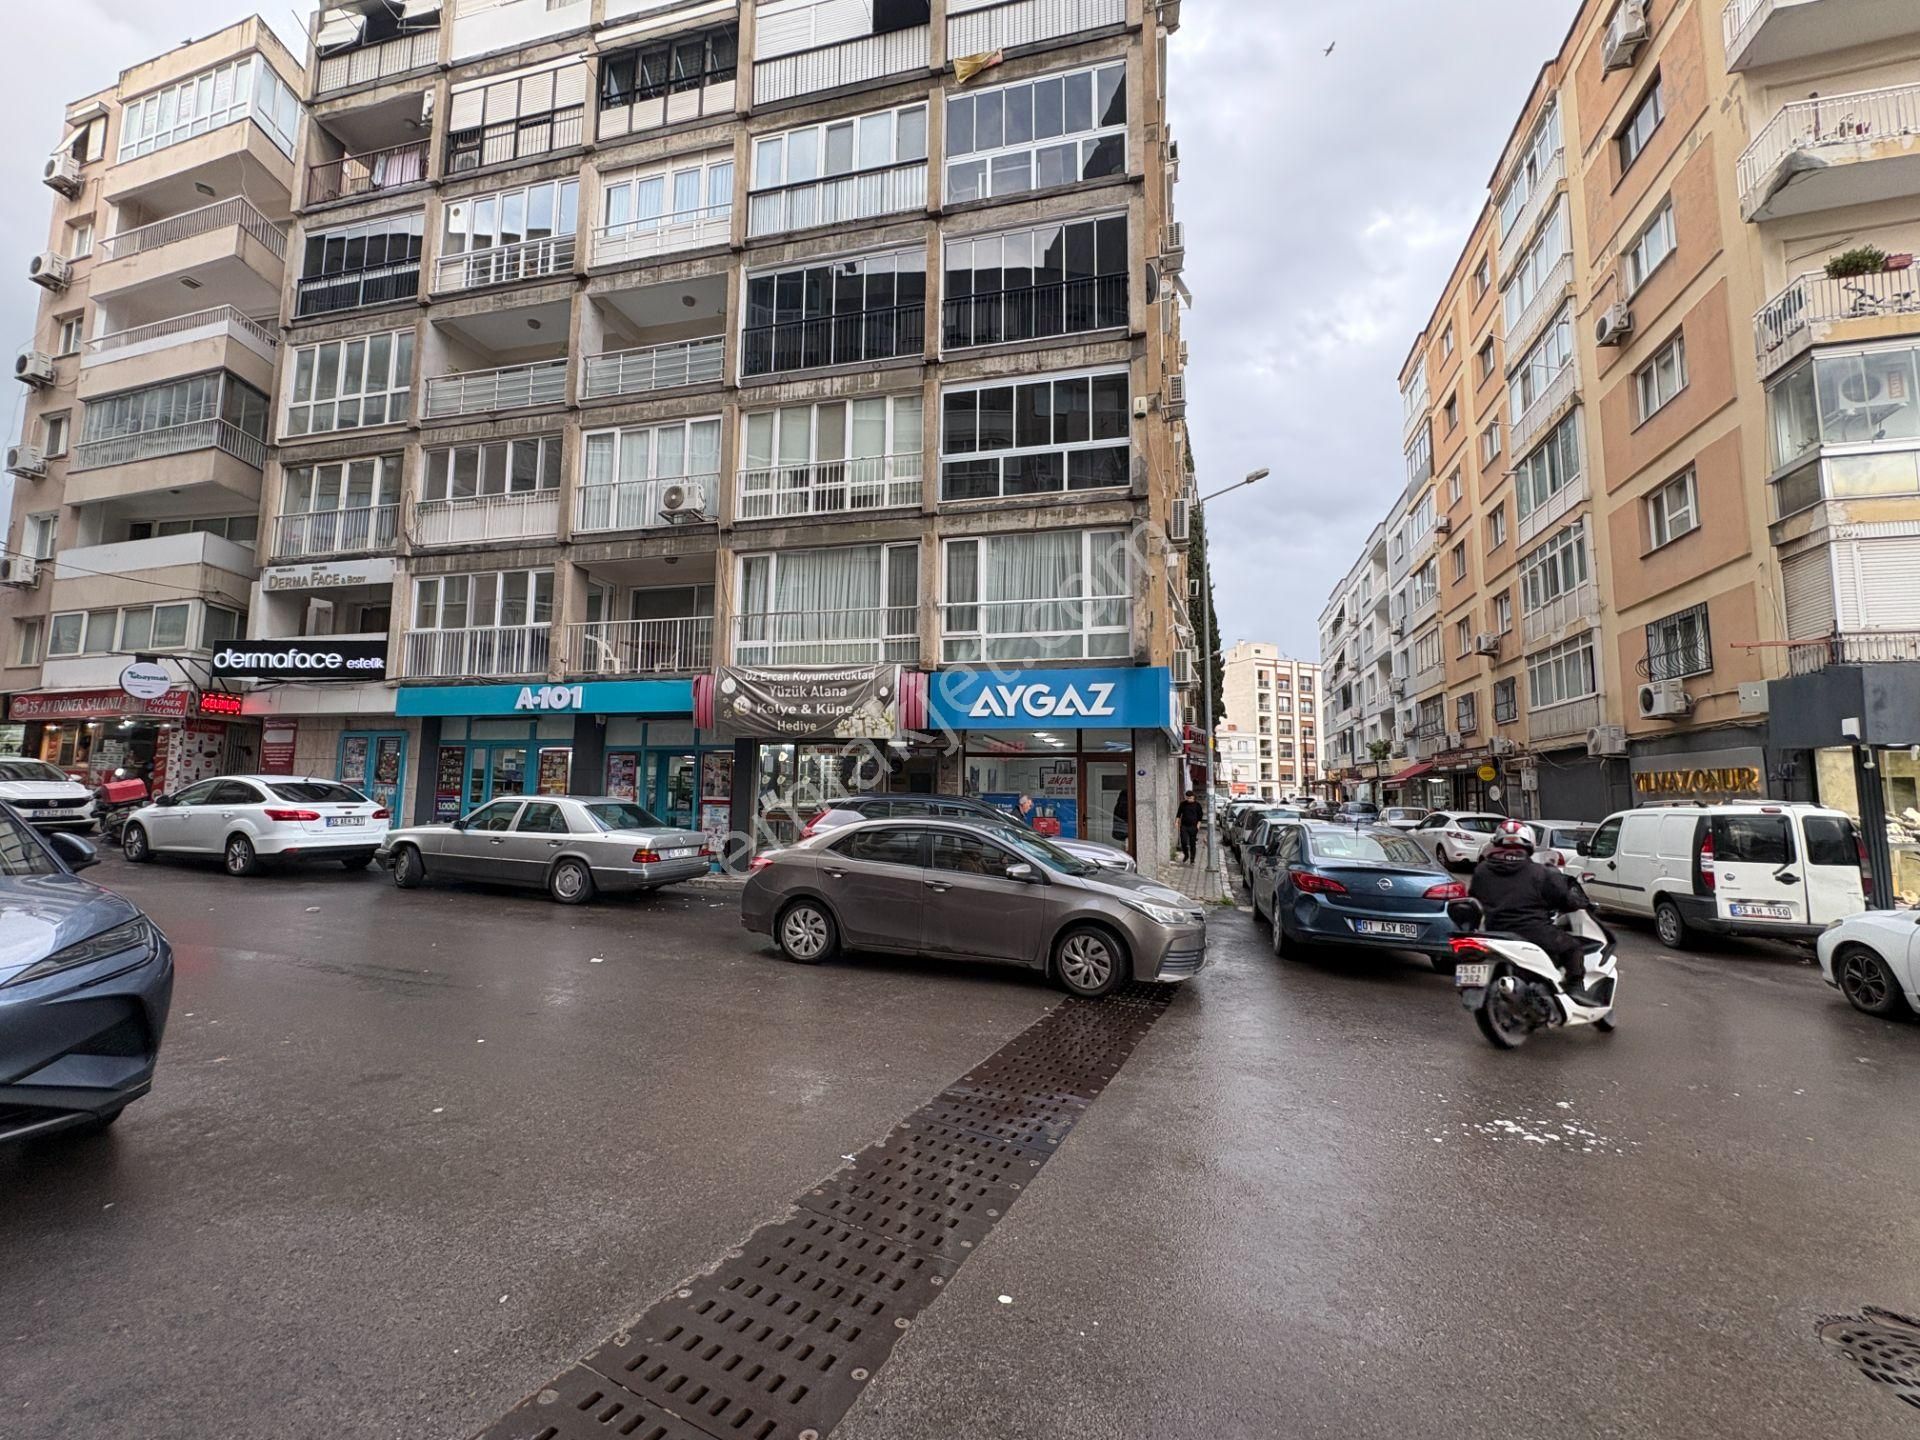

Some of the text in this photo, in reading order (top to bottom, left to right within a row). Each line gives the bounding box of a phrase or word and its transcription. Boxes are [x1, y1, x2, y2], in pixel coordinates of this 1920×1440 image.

[268, 575, 309, 589] DERMA
[311, 571, 340, 587] FACE
[214, 648, 385, 669] dermaface estetik
[760, 671, 790, 682] Ercan
[769, 685, 848, 698] Yüzük Alana
[28, 701, 39, 713] 35
[39, 700, 54, 713] AY
[53, 696, 86, 712] DÖNER
[84, 696, 122, 712] SALONU
[151, 697, 182, 707] DÖNER
[968, 683, 1116, 717] AYGAZ
[146, 706, 184, 715] SALONU
[757, 703, 853, 717] Kolye & Küpe
[777, 720, 817, 733] Hediye
[1362, 920, 1373, 930] 01
